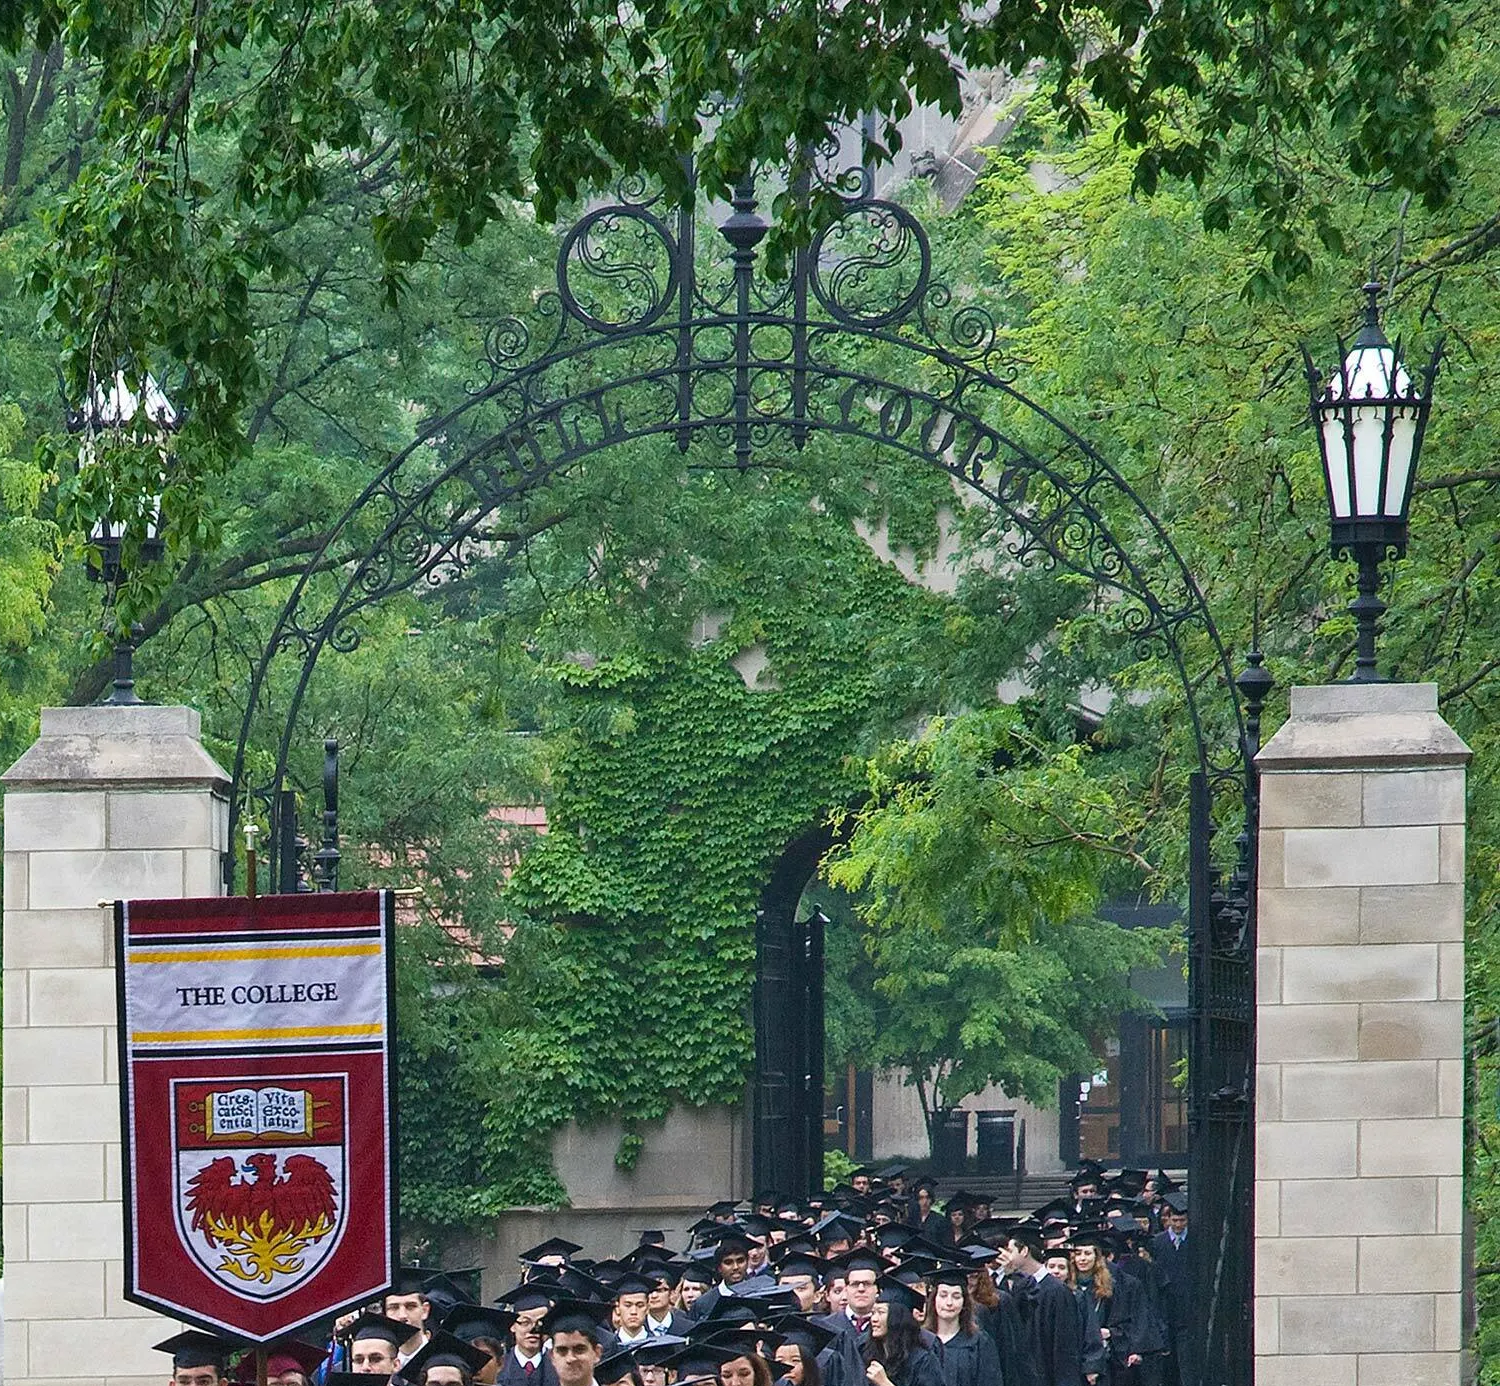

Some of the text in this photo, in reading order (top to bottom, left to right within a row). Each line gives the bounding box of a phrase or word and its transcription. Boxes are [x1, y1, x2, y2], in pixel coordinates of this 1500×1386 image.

[838, 378, 1032, 503] COURT
[176, 983, 338, 1007] THE COLLEGE
[264, 1091, 296, 1106] Vita
[219, 1117, 253, 1129] entia
[263, 1116, 299, 1129] latur
